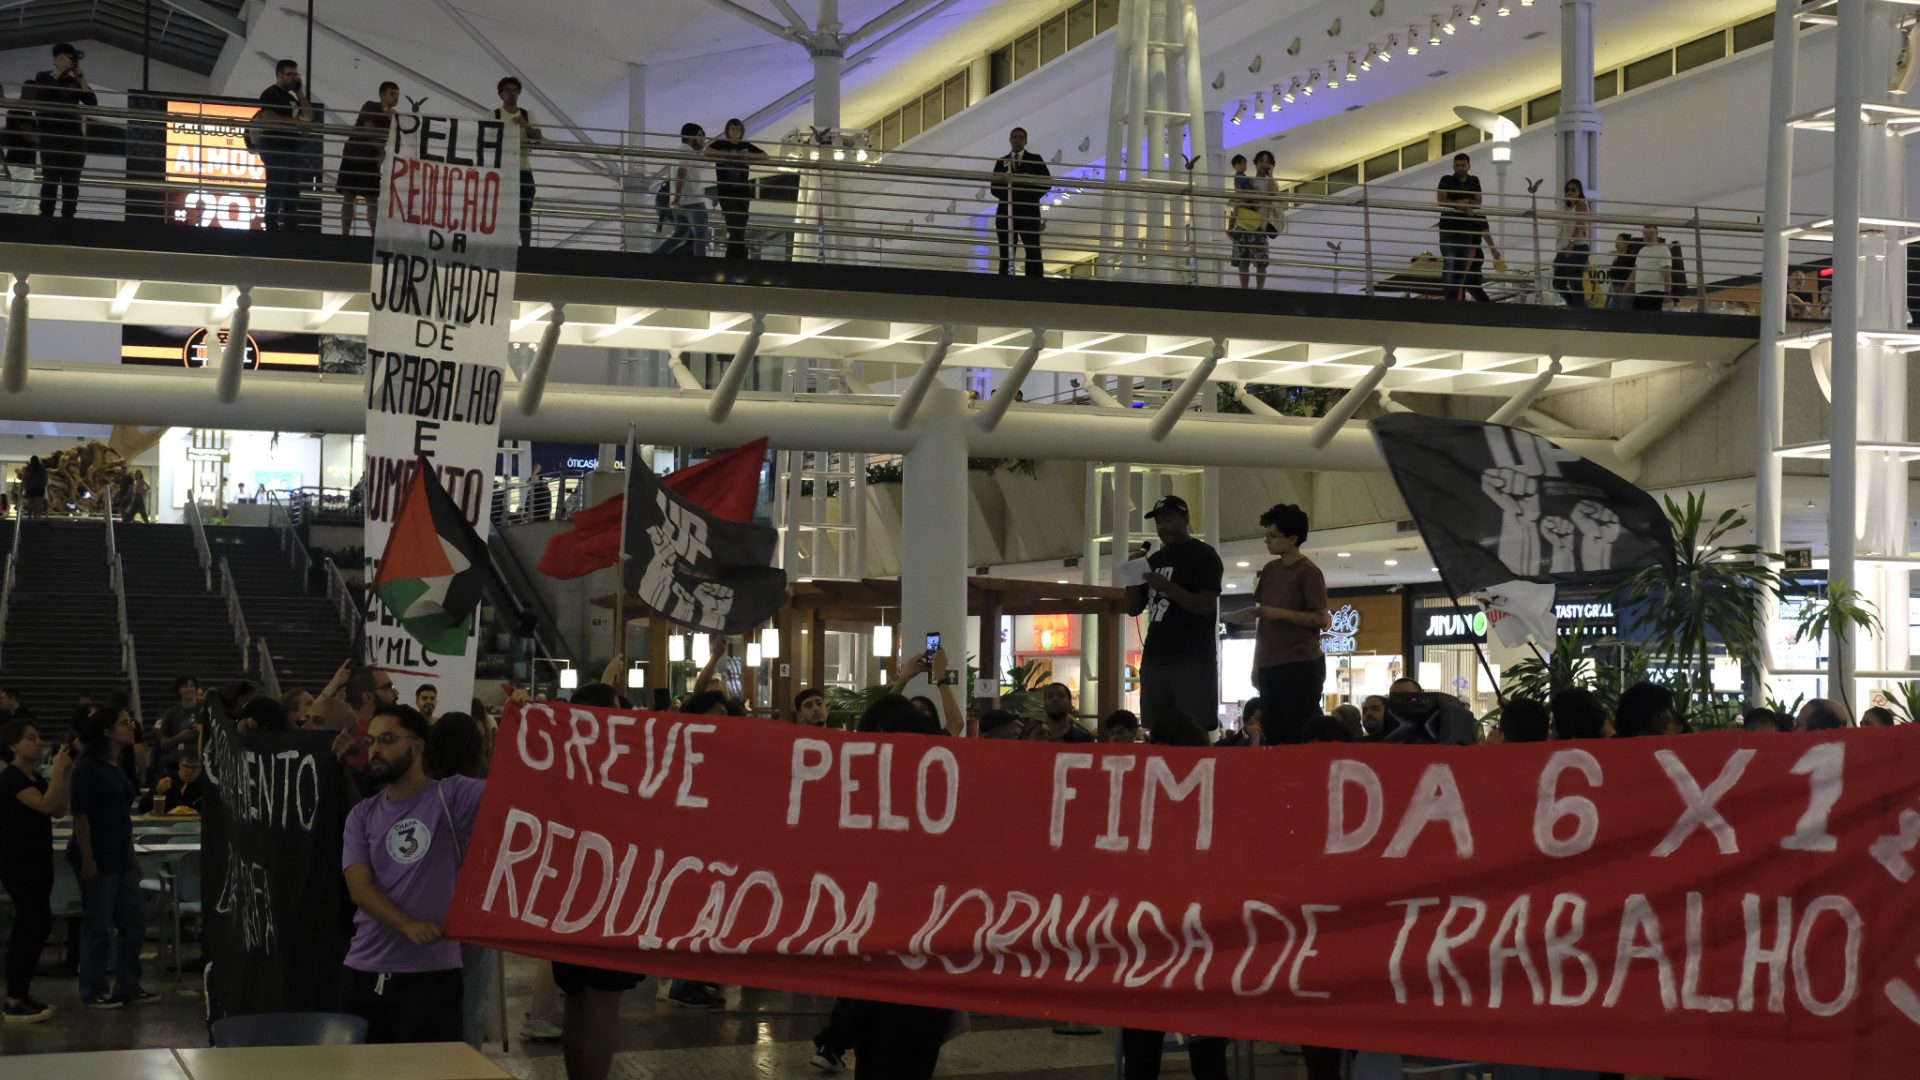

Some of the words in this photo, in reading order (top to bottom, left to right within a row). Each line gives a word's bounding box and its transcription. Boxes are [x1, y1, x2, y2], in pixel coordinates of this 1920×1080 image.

[173, 144, 266, 180] ALMOÇ
[394, 114, 505, 169] PELA
[388, 156, 501, 235] REDUÇÃO
[428, 229, 467, 253] DA
[371, 250, 501, 326] JORNADA
[415, 319, 457, 352] DE
[366, 348, 501, 425] TRABALHO
[413, 420, 441, 457] E
[516, 701, 717, 809] GREVE
[786, 737, 960, 835] PELO
[1049, 752, 1217, 851] FIM
[1324, 758, 1475, 859] DA
[1533, 747, 1604, 858] 6
[1650, 748, 1758, 858] X
[1780, 741, 1847, 853] 1
[393, 820, 418, 831] CHAPA
[398, 827, 419, 858] 3
[481, 807, 784, 954] REDUÇÃO
[777, 873, 878, 961] DA
[888, 884, 1214, 992] JORNADA
[1231, 899, 1341, 999] DE
[1386, 890, 1865, 1017] TRABALHO
